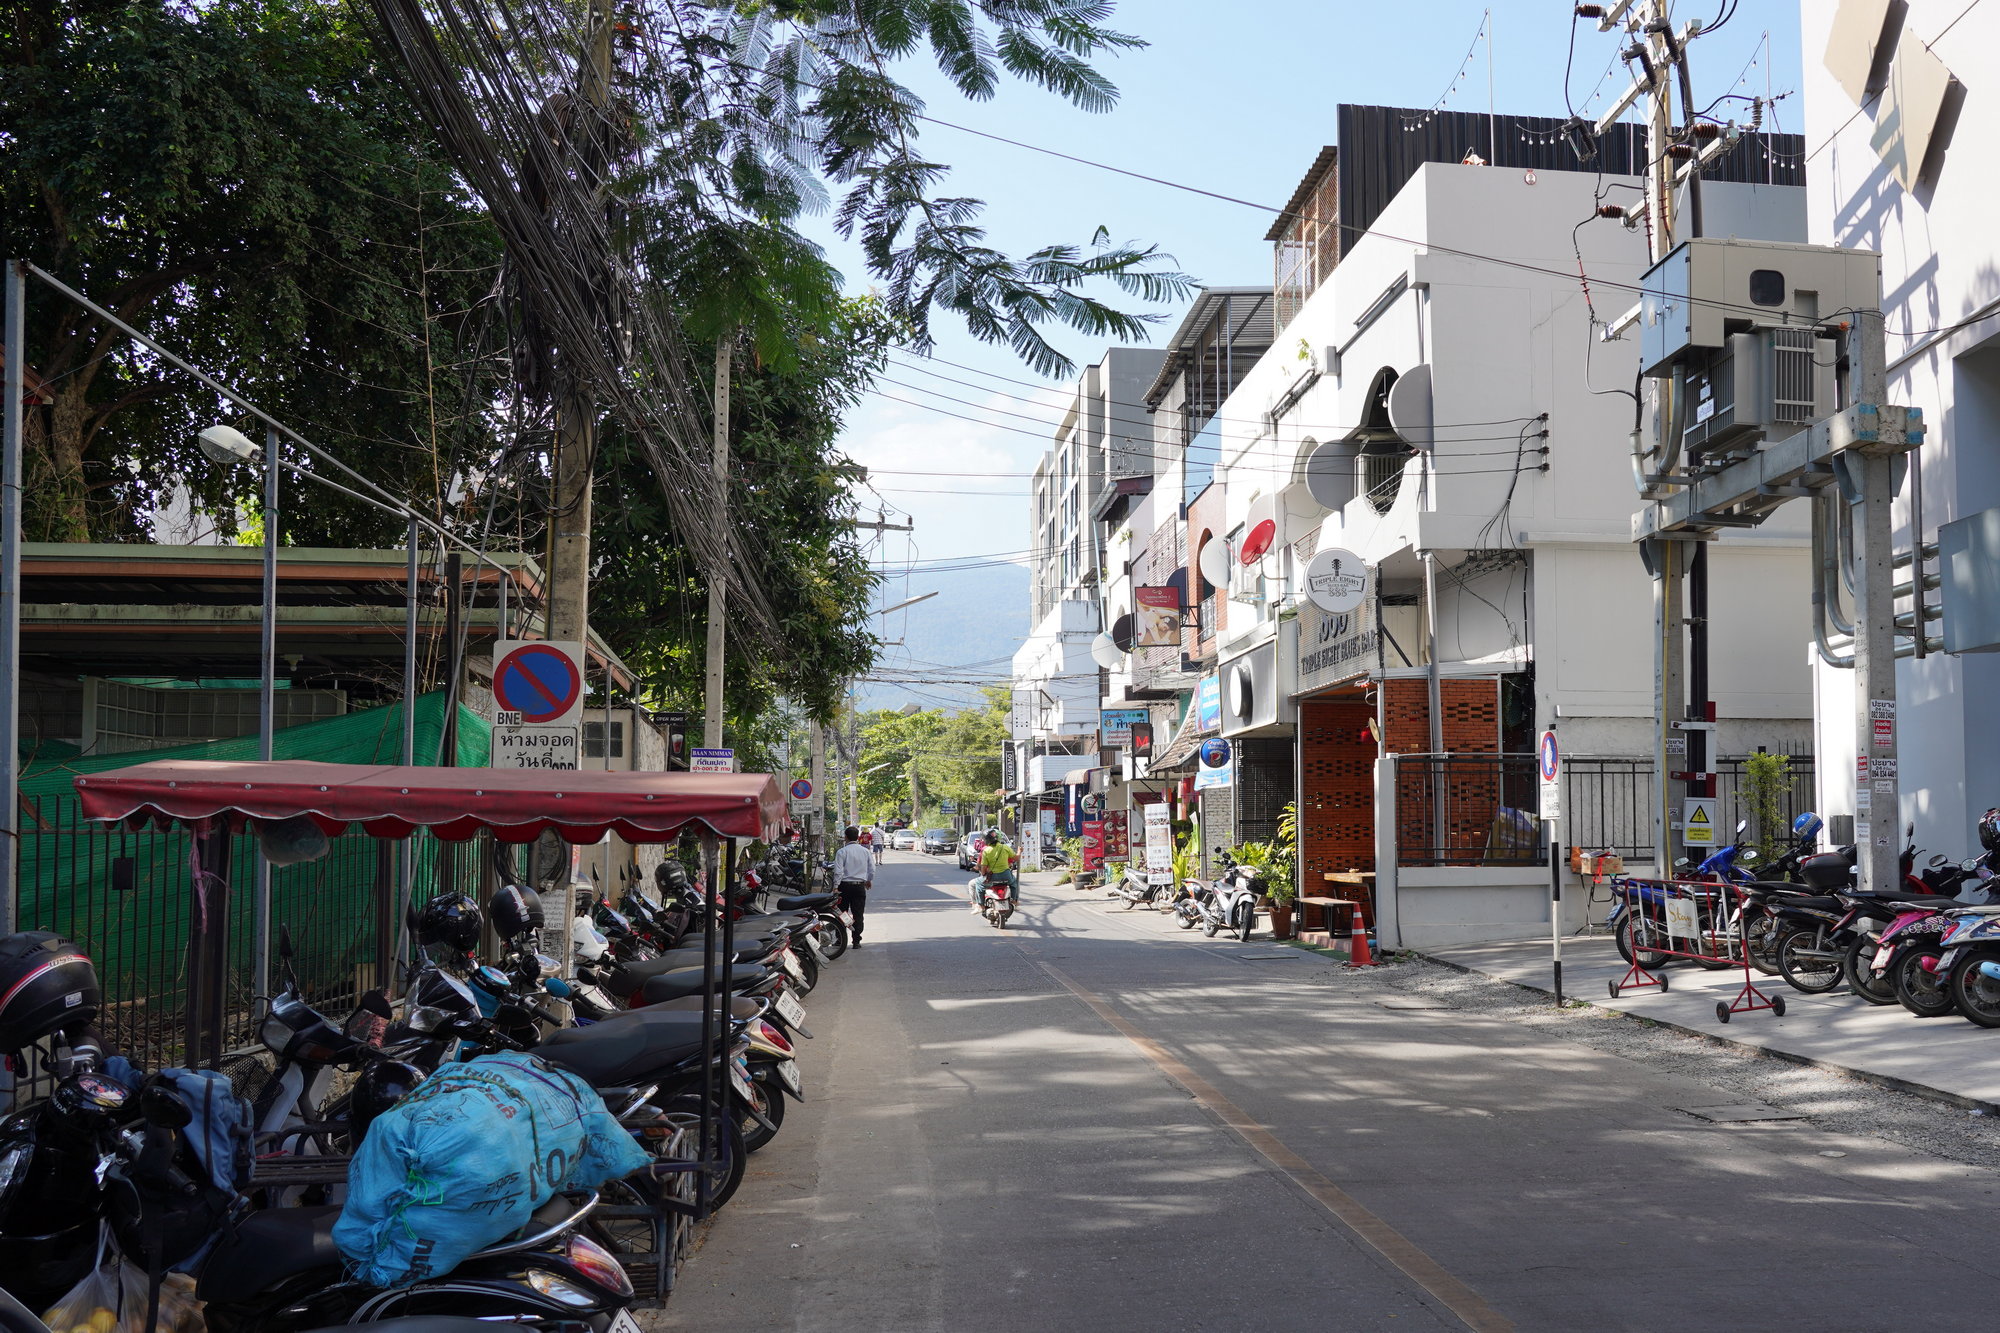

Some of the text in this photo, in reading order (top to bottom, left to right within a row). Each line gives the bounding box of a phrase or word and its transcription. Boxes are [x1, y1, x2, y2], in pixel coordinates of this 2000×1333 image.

[1315, 576, 1360, 586] TRIPLE EIGHT
[1301, 629, 1377, 675] TRIPLE EIGHT BLUES BAR
[497, 713, 520, 724] BNE
[501, 728, 574, 746] ห้ามจอด
[697, 758, 726, 766] ที่ดินเปล่า
